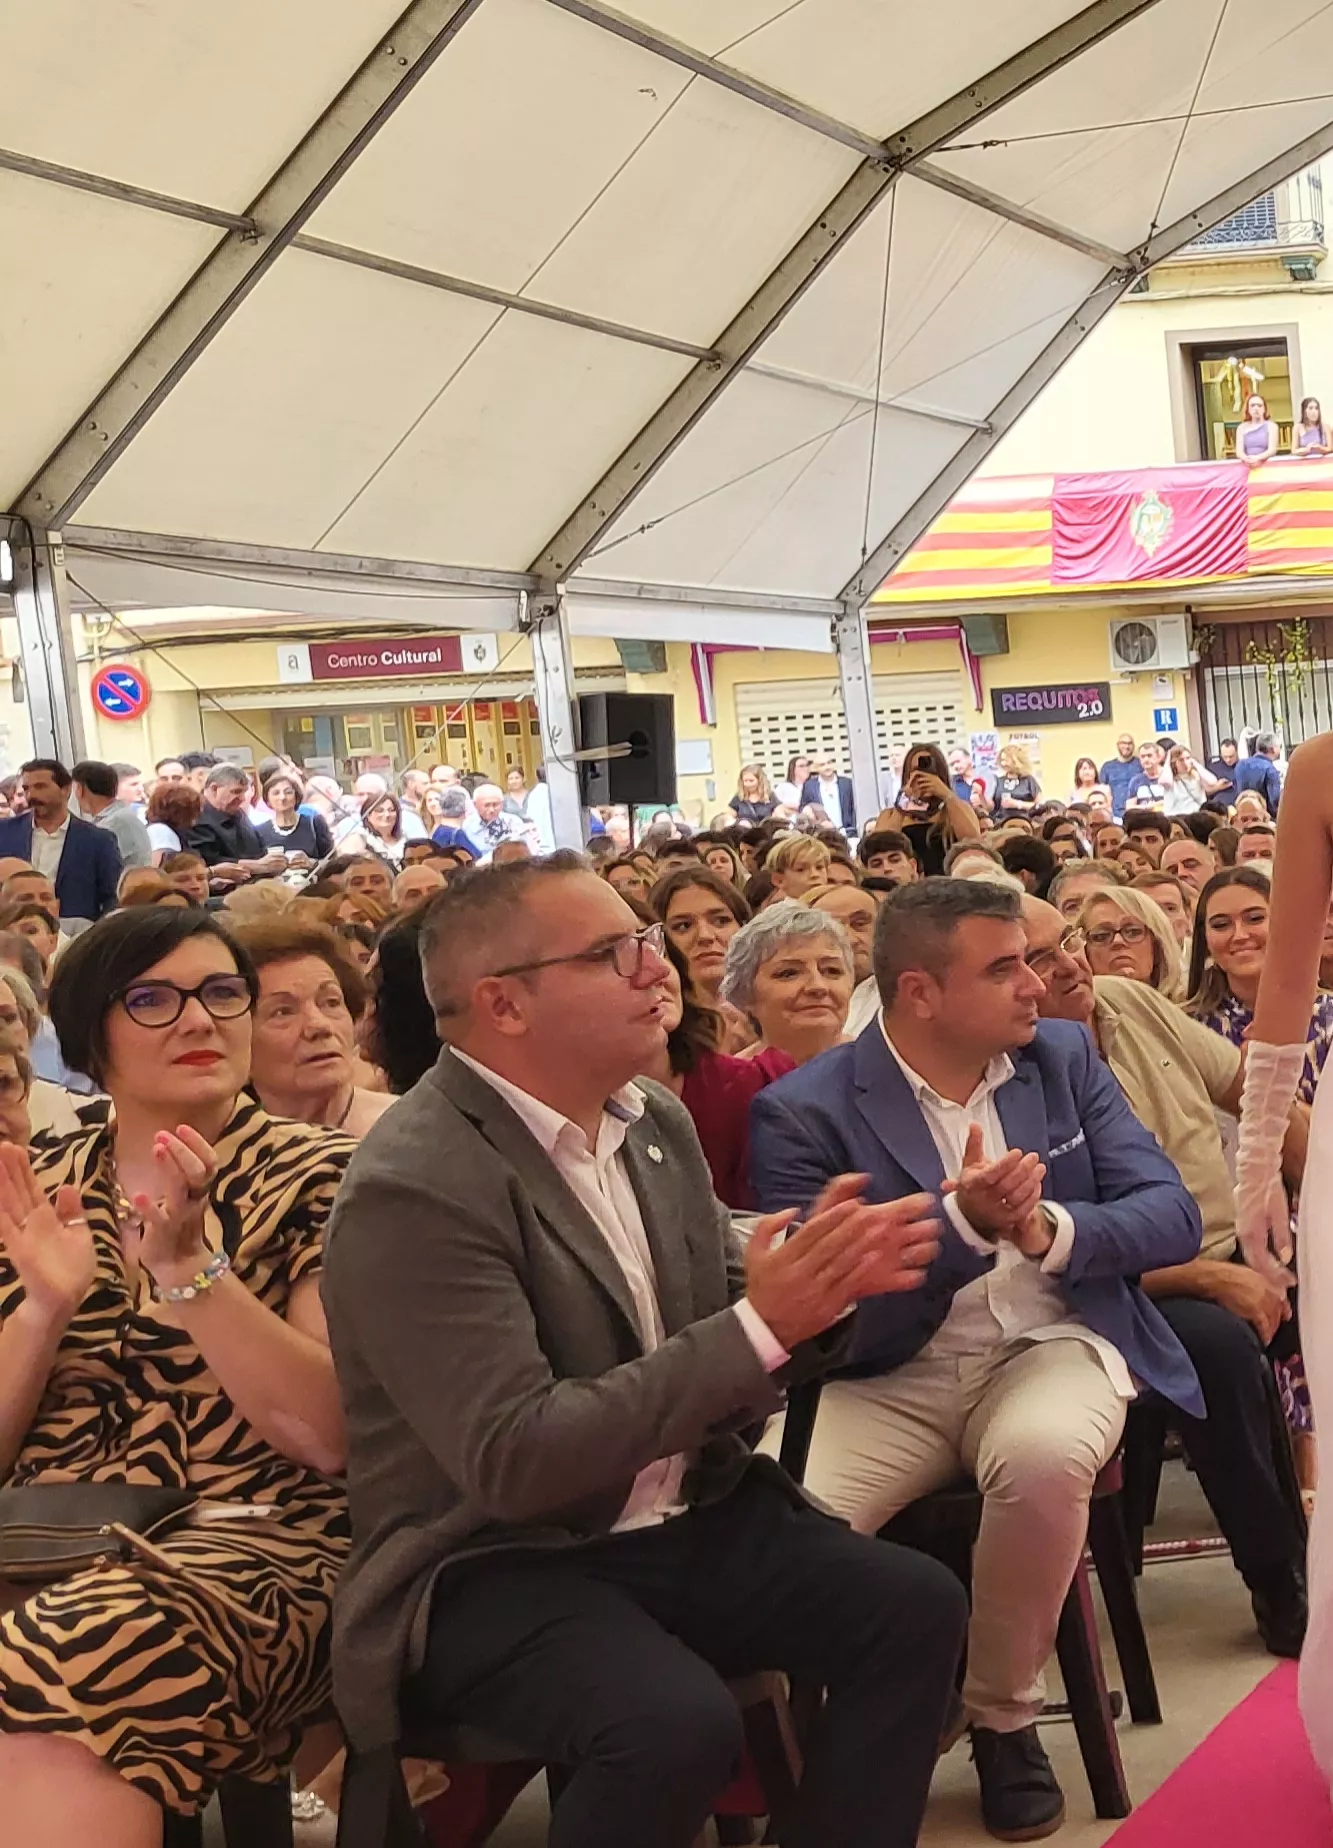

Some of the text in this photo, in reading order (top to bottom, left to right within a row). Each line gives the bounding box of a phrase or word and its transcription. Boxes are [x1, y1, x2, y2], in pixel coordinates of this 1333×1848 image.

[327, 647, 442, 669] Centro Cultural
[1077, 699, 1103, 719] 2.0
